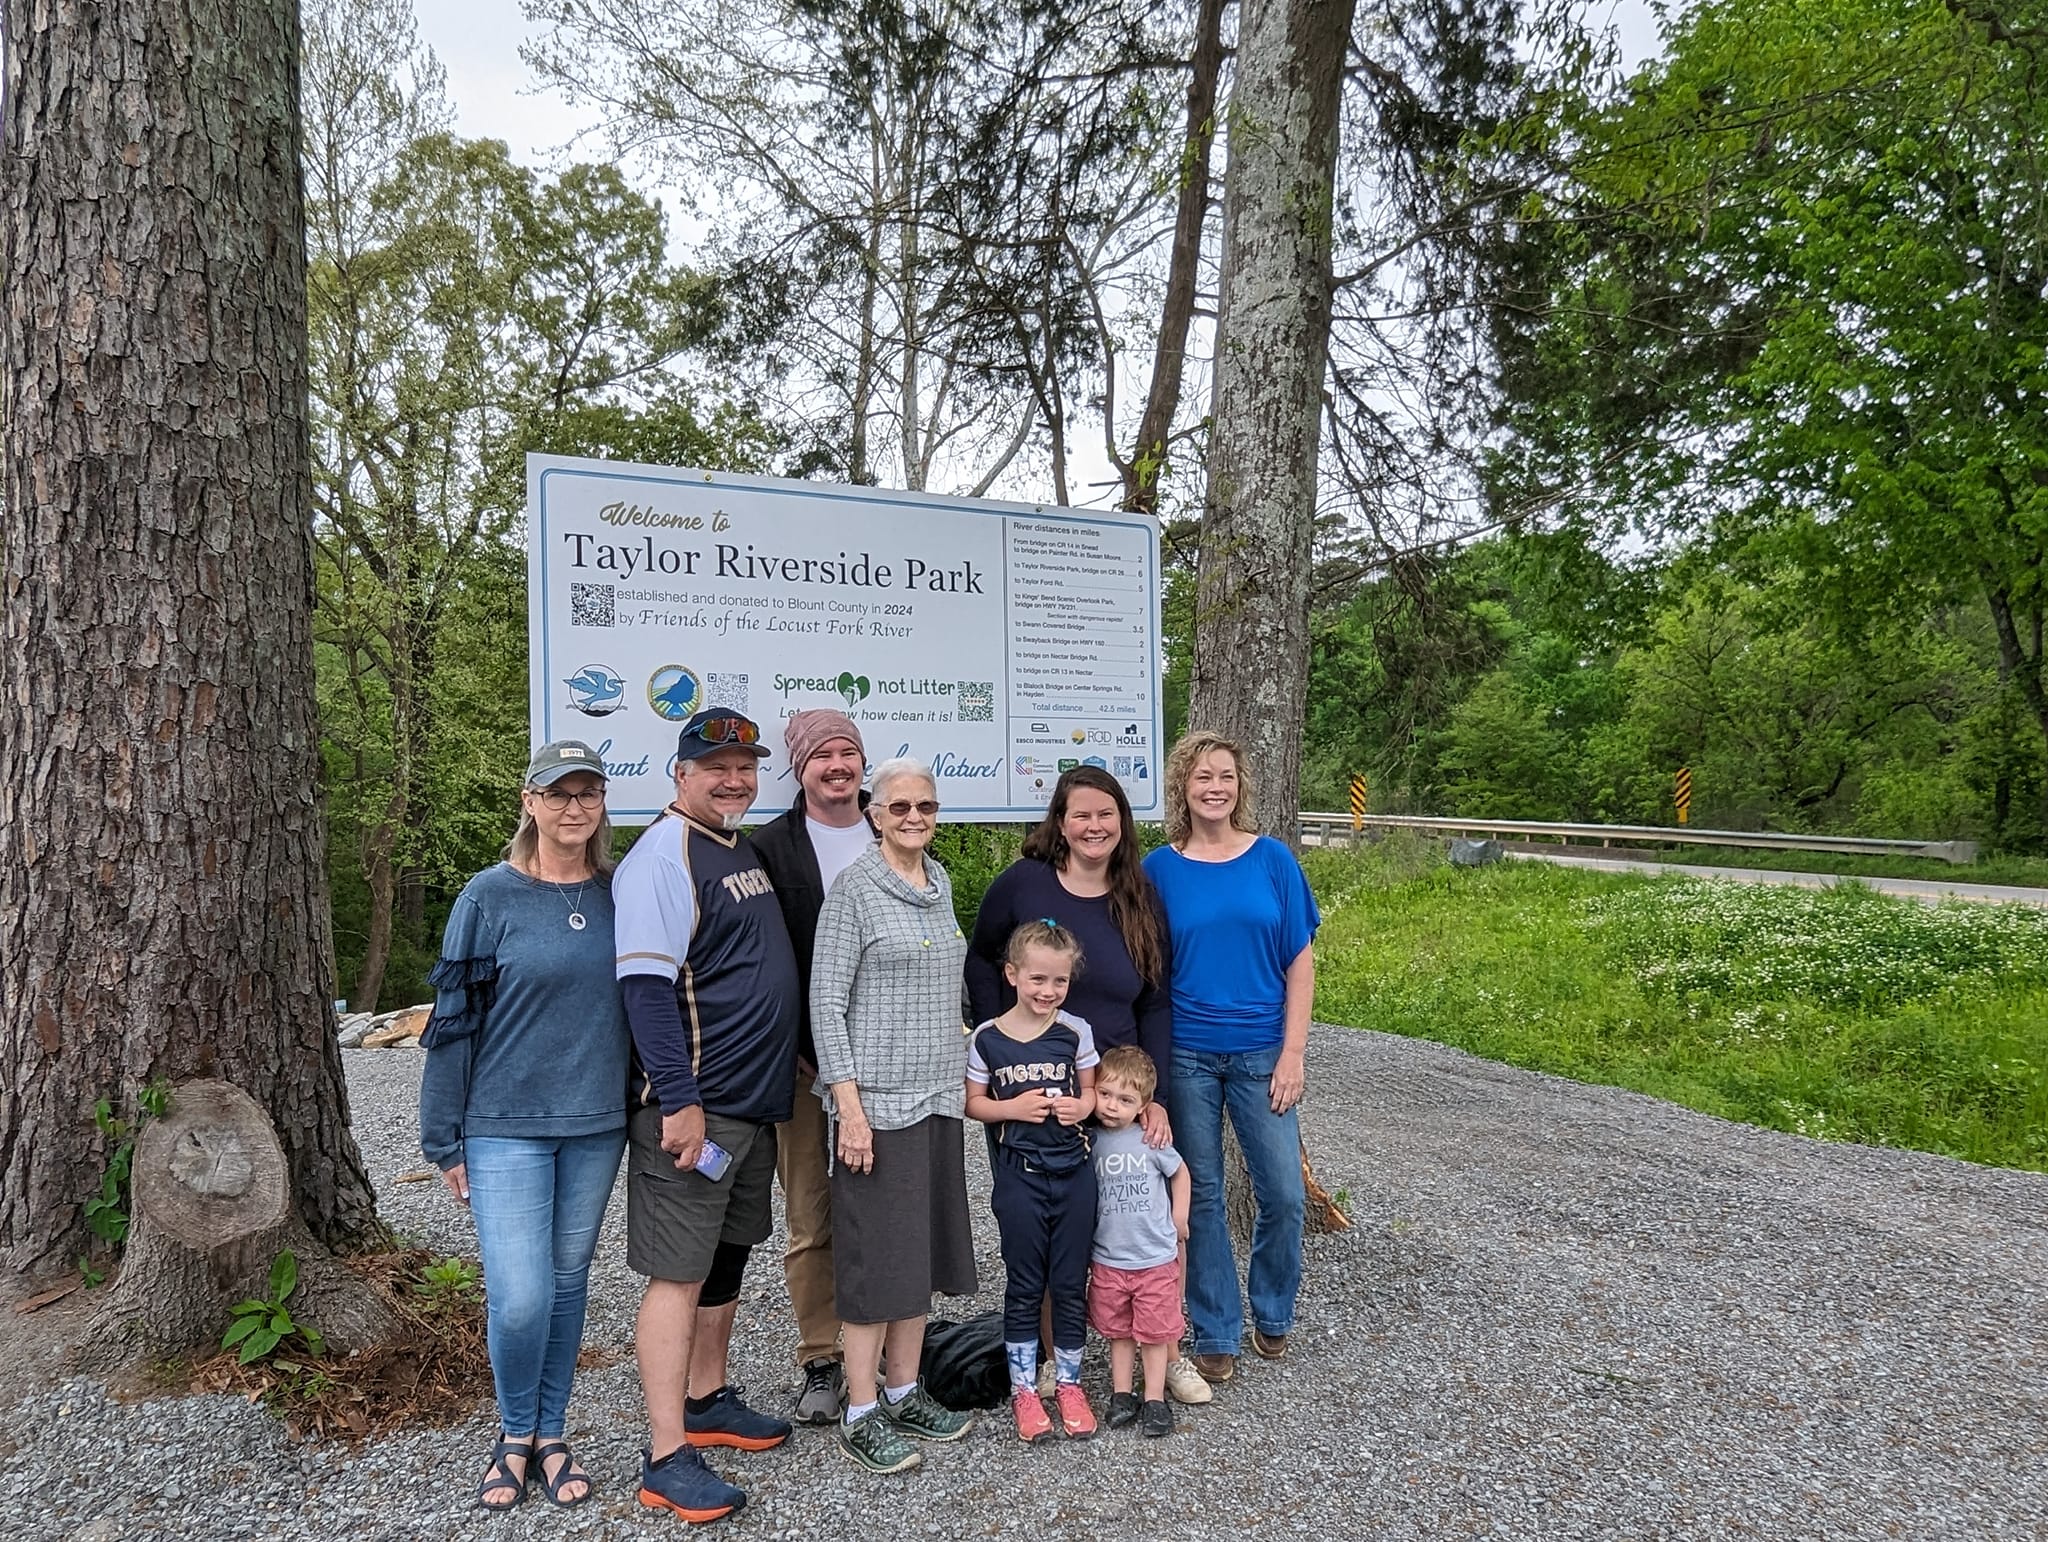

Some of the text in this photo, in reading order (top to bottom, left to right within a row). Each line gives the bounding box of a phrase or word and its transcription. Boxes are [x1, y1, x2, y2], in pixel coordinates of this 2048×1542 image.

[599, 501, 731, 533] Welcome to
[1014, 522, 1033, 530] River
[1035, 524, 1070, 534] distances
[1080, 529, 1100, 537] miles
[1021, 547, 1039, 555] bridge
[1138, 556, 1143, 564] 2
[564, 532, 985, 595] Taylor Riverside Park
[1022, 562, 1039, 570] Taylor
[1138, 570, 1143, 578] 6
[1022, 578, 1039, 586] Taylor
[1138, 584, 1144, 592] 5
[617, 588, 913, 616] established and donated to Blount County in 2024
[619, 608, 913, 638] by Friends of the Locust Fork River
[1132, 626, 1144, 634] 3.5
[1022, 636, 1051, 644] Swayback
[1052, 638, 1070, 646] Bridge
[1070, 654, 1088, 662] Bridge
[1140, 656, 1144, 664] 2
[1140, 670, 1145, 678] 5
[773, 674, 955, 699] Spread not Litter
[1046, 683, 1064, 691] Bridge
[1023, 690, 1045, 698] Hayden
[1032, 702, 1050, 710] Total
[1052, 704, 1084, 712] distance
[1098, 704, 1114, 713] 42.5
[861, 710, 888, 720] how
[891, 710, 924, 722] clean
[927, 711, 936, 722] it
[938, 712, 953, 722] is!
[1116, 736, 1147, 745] HOLLE
[930, 752, 1003, 779] Nature!
[995, 1063, 1067, 1087] TIGERS
[1121, 1200, 1151, 1214] FIVES
